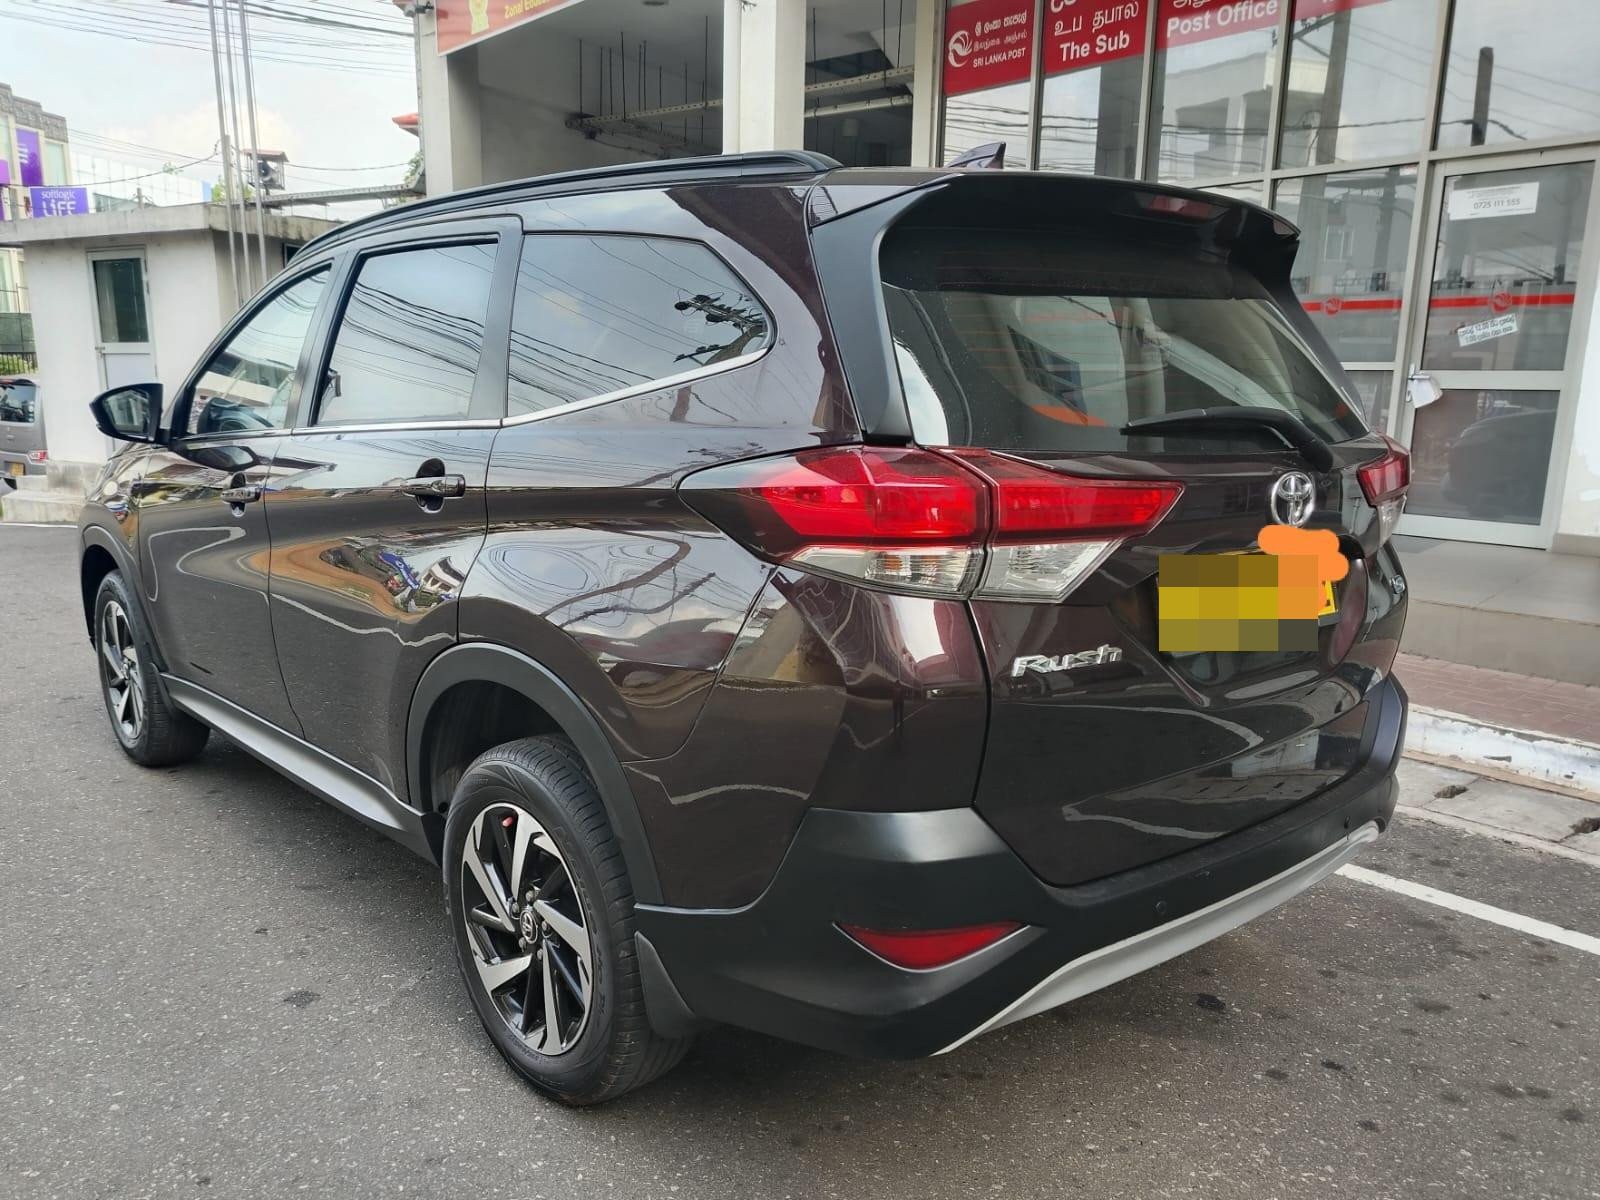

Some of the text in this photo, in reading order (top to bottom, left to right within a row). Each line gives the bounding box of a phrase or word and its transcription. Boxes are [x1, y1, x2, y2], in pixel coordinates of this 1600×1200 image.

[1166, 0, 1278, 39] Post Office
[973, 47, 1027, 69] SRI LANKA POST
[1060, 30, 1130, 62] The Sub
[1473, 200, 1492, 210] 0725
[1011, 643, 1122, 678] Rush
